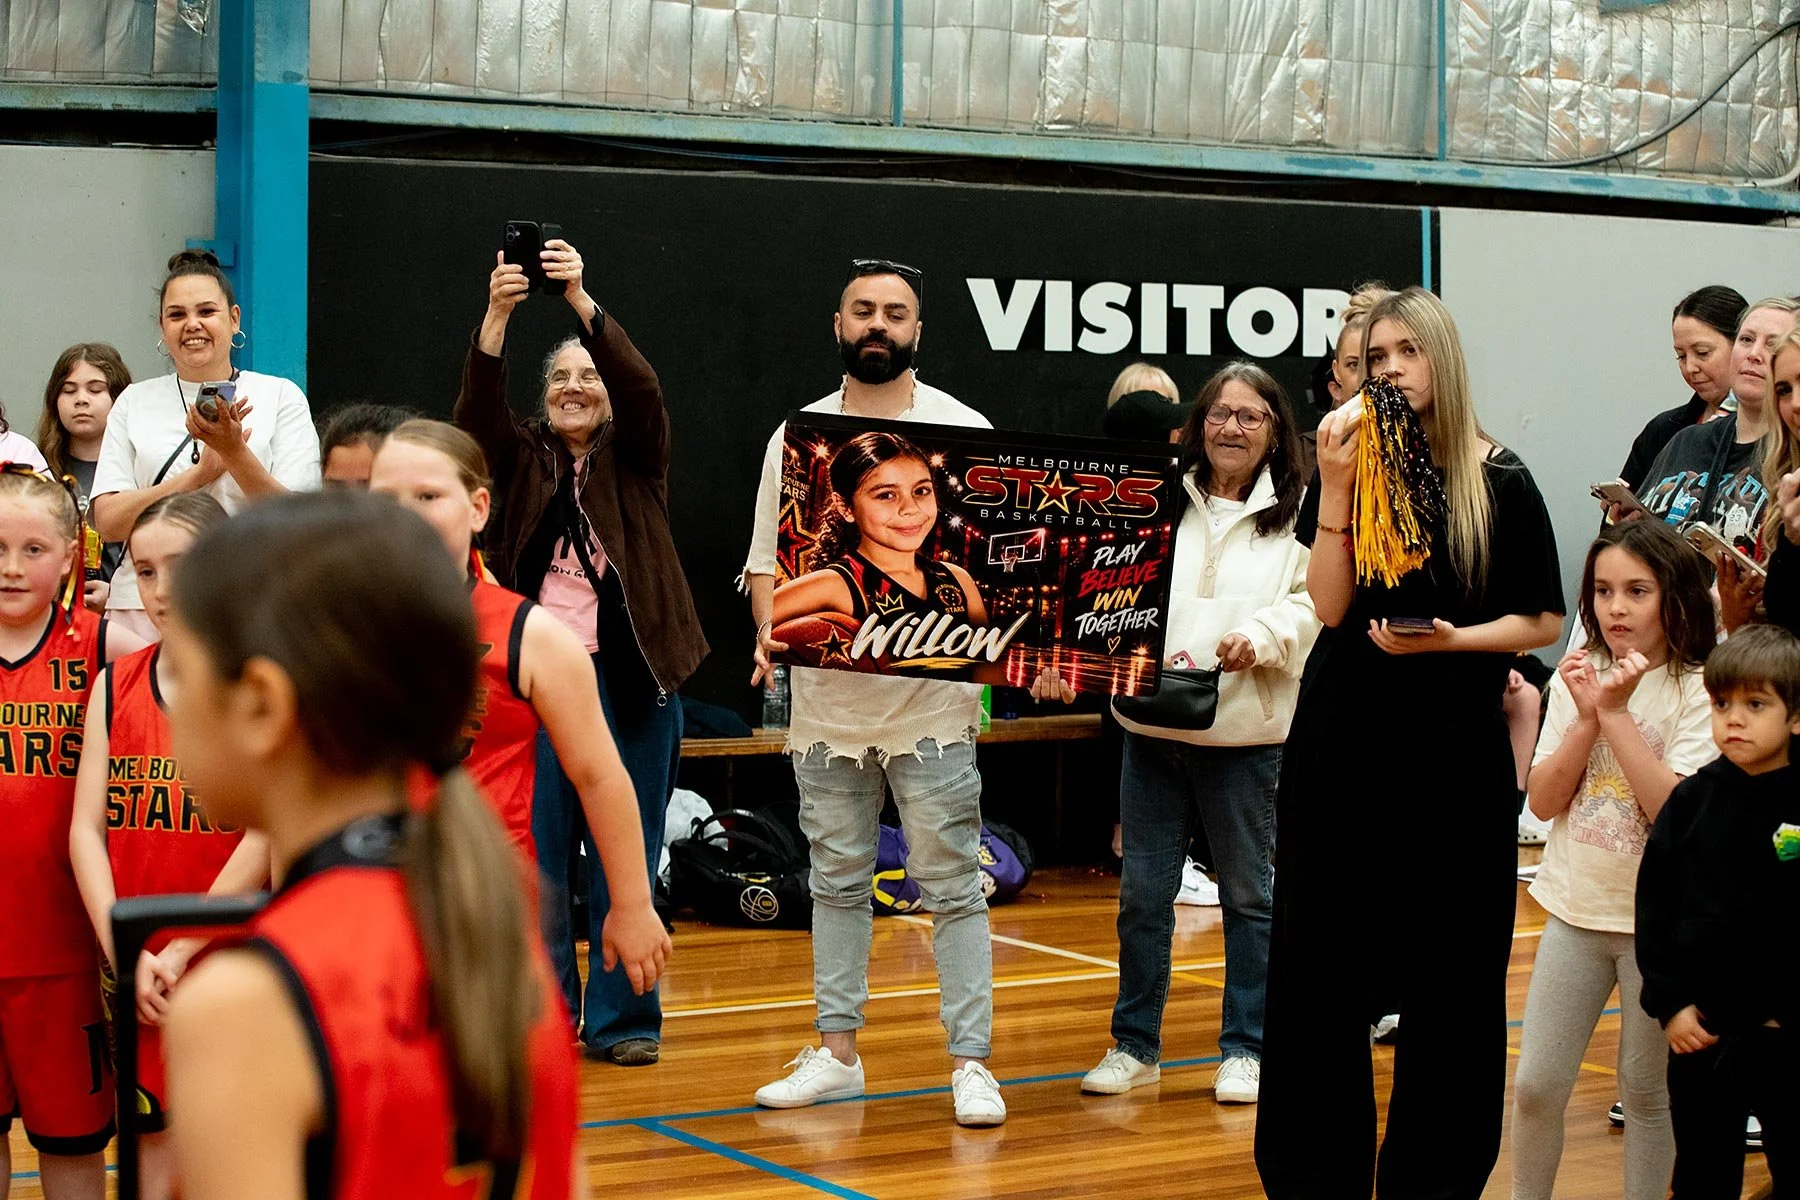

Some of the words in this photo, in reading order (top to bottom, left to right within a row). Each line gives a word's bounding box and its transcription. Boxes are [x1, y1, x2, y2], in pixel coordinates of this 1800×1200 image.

[966, 278, 1350, 358] VISITOR
[998, 454, 1131, 475] MELBOURNE
[980, 508, 1132, 530] BASKETBALL
[1092, 540, 1146, 569] PLAY
[1078, 559, 1162, 598] BELIEVE
[1093, 584, 1143, 611] WIN
[1075, 608, 1160, 640] TOGETHER
[48, 657, 88, 692] 15
[107, 784, 241, 834] STAR
